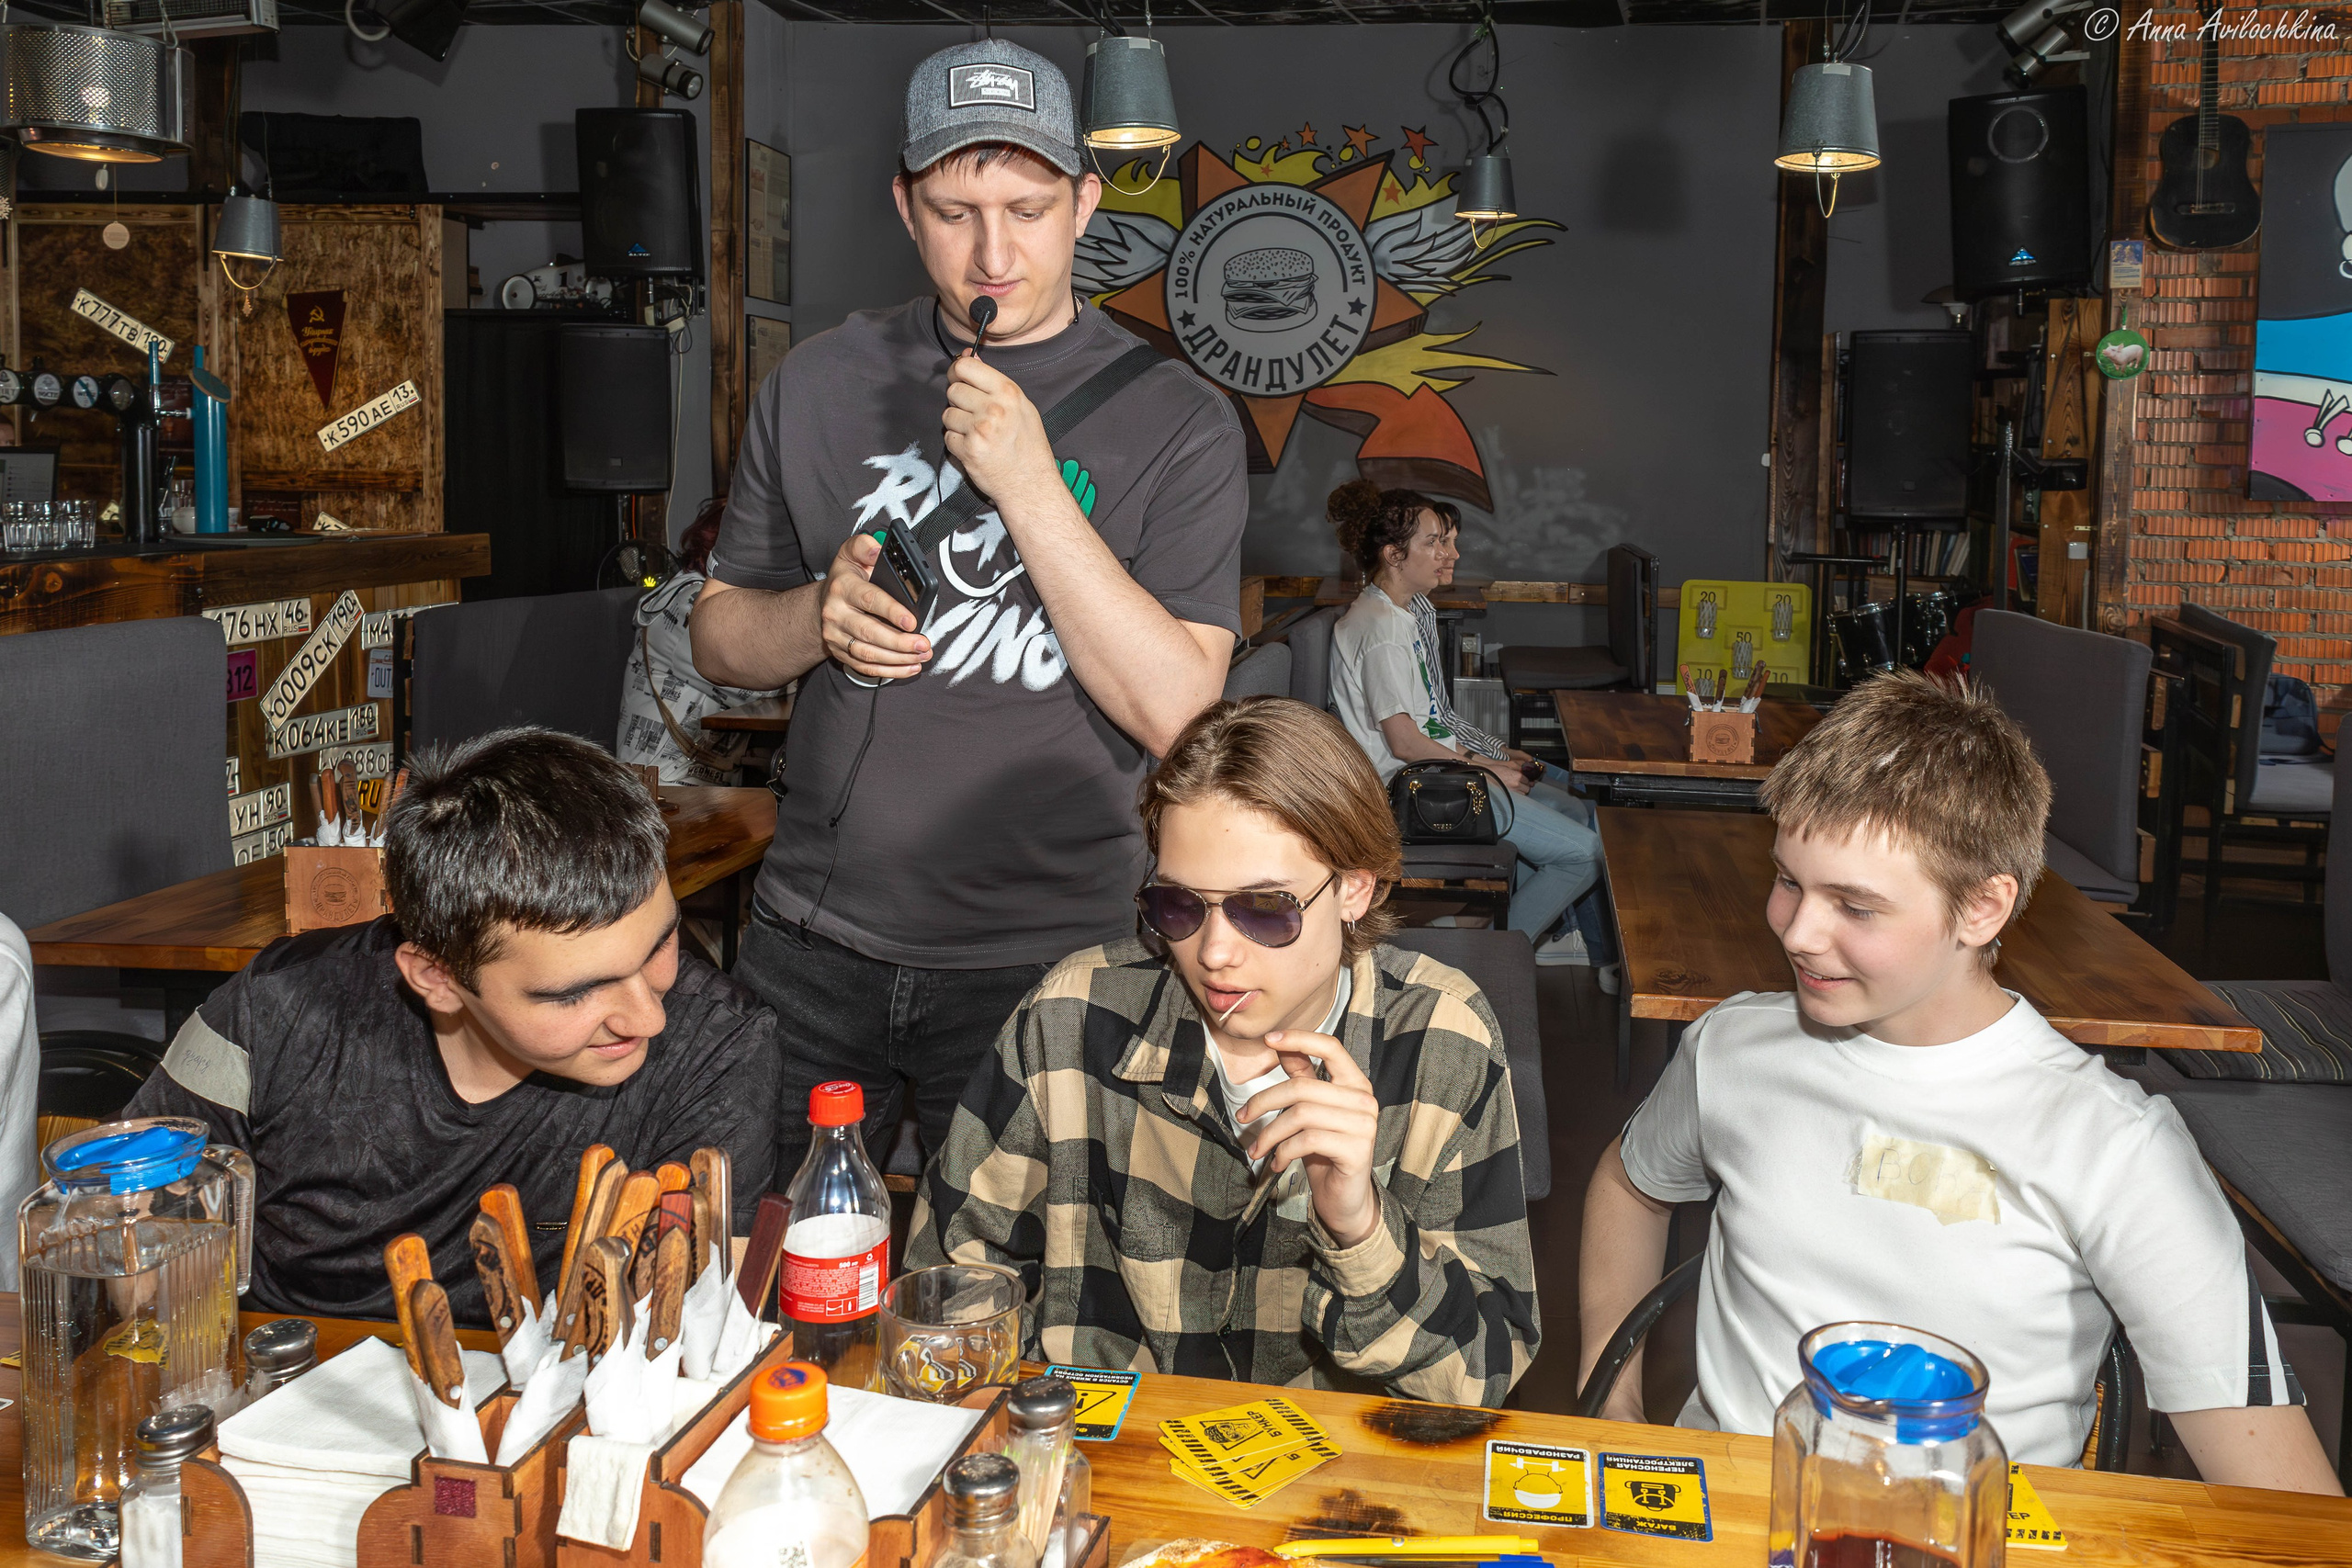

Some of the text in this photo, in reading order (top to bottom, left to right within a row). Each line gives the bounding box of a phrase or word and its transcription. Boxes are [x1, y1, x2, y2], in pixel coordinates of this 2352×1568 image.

[1174, 192, 1365, 299] 100% НАТУРАЛЬНЫЙ ПРОДУКТ
[78, 298, 139, 342] К777ТВ
[1182, 314, 1359, 392] ДРАНДУЛЕТ
[326, 384, 411, 446] К590АЕ 13
[1700, 591, 1716, 603] 20
[284, 601, 304, 624] 46
[331, 595, 356, 629] 190
[283, 625, 299, 634] RUS
[343, 619, 356, 635] RUS
[1736, 631, 1752, 644] 50
[264, 787, 283, 814] 90
[266, 827, 285, 852] 50
[1246, 1410, 1283, 1438] БУНКЕР
[1496, 1445, 1580, 1460] РАЗНОРАБОЧИЙ
[1606, 1456, 1695, 1468] ЭЛЕКТРОСТАНЦИЯ
[1616, 1462, 1686, 1473] ПЕРЕНОСНАЯ
[1503, 1510, 1573, 1523] ПРОФЕССИЯ
[1636, 1520, 1677, 1531] БАГАЖ
